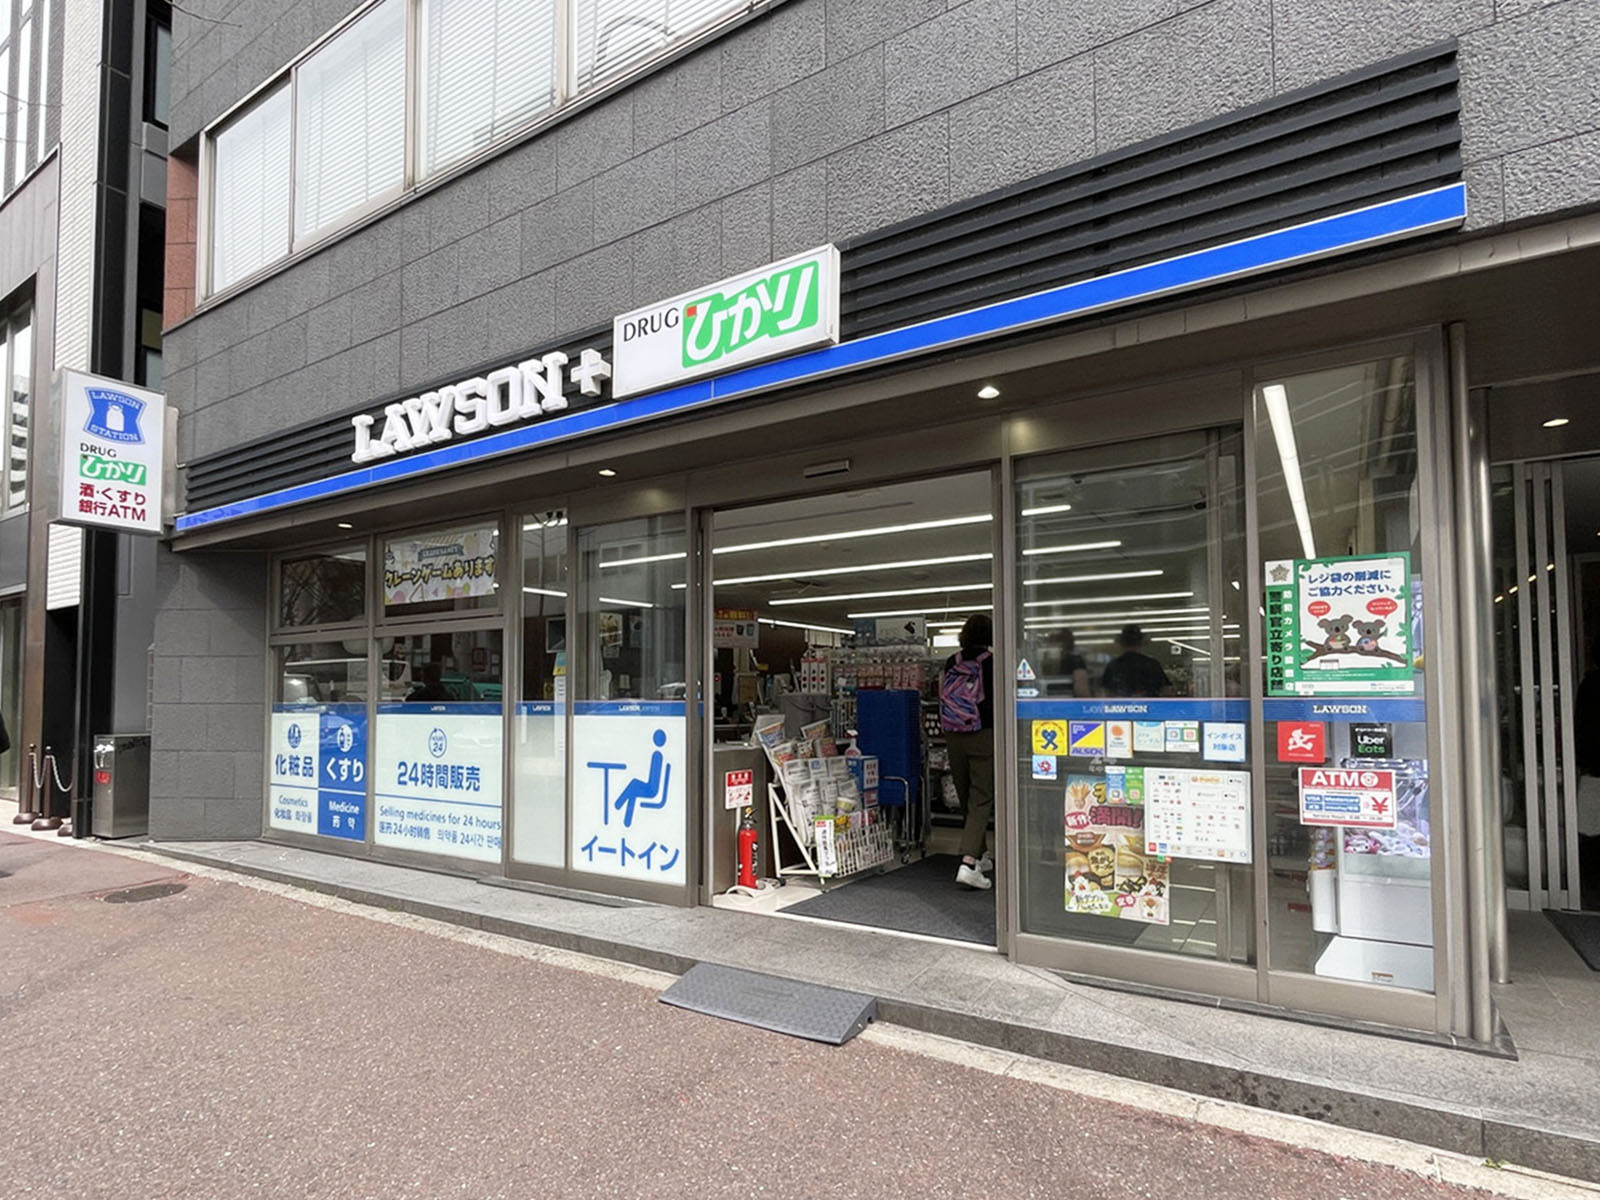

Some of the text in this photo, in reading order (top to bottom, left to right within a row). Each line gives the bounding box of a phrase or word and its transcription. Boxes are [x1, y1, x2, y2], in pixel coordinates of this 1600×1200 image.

[686, 264, 817, 362] ひかり
[622, 307, 679, 342] DRUG
[91, 391, 142, 411] LAWSON
[89, 424, 139, 441] STATION
[80, 442, 117, 459] DRUG
[81, 455, 146, 484] ひかり
[78, 499, 147, 522] 銀行ATM
[1308, 569, 1391, 585] レジ袋の削減に
[1307, 585, 1396, 598] ご協力ください。
[1104, 704, 1148, 714] LAWSON
[1313, 704, 1369, 715] LAWSON
[1207, 731, 1243, 740] インボイス
[1357, 735, 1385, 745] Uber
[433, 742, 444, 753] 24
[1071, 747, 1104, 756] ALSOK
[1358, 744, 1386, 753] Eats
[275, 753, 314, 778] 化粧品
[326, 757, 365, 783] くすり
[397, 761, 481, 792] 24時間販売
[1310, 771, 1360, 788] ATM
[279, 794, 309, 808] Cosmetics
[328, 800, 361, 815] Medicine
[379, 805, 502, 831] Selling medicines for 24 hours
[580, 835, 680, 872] イートイン
